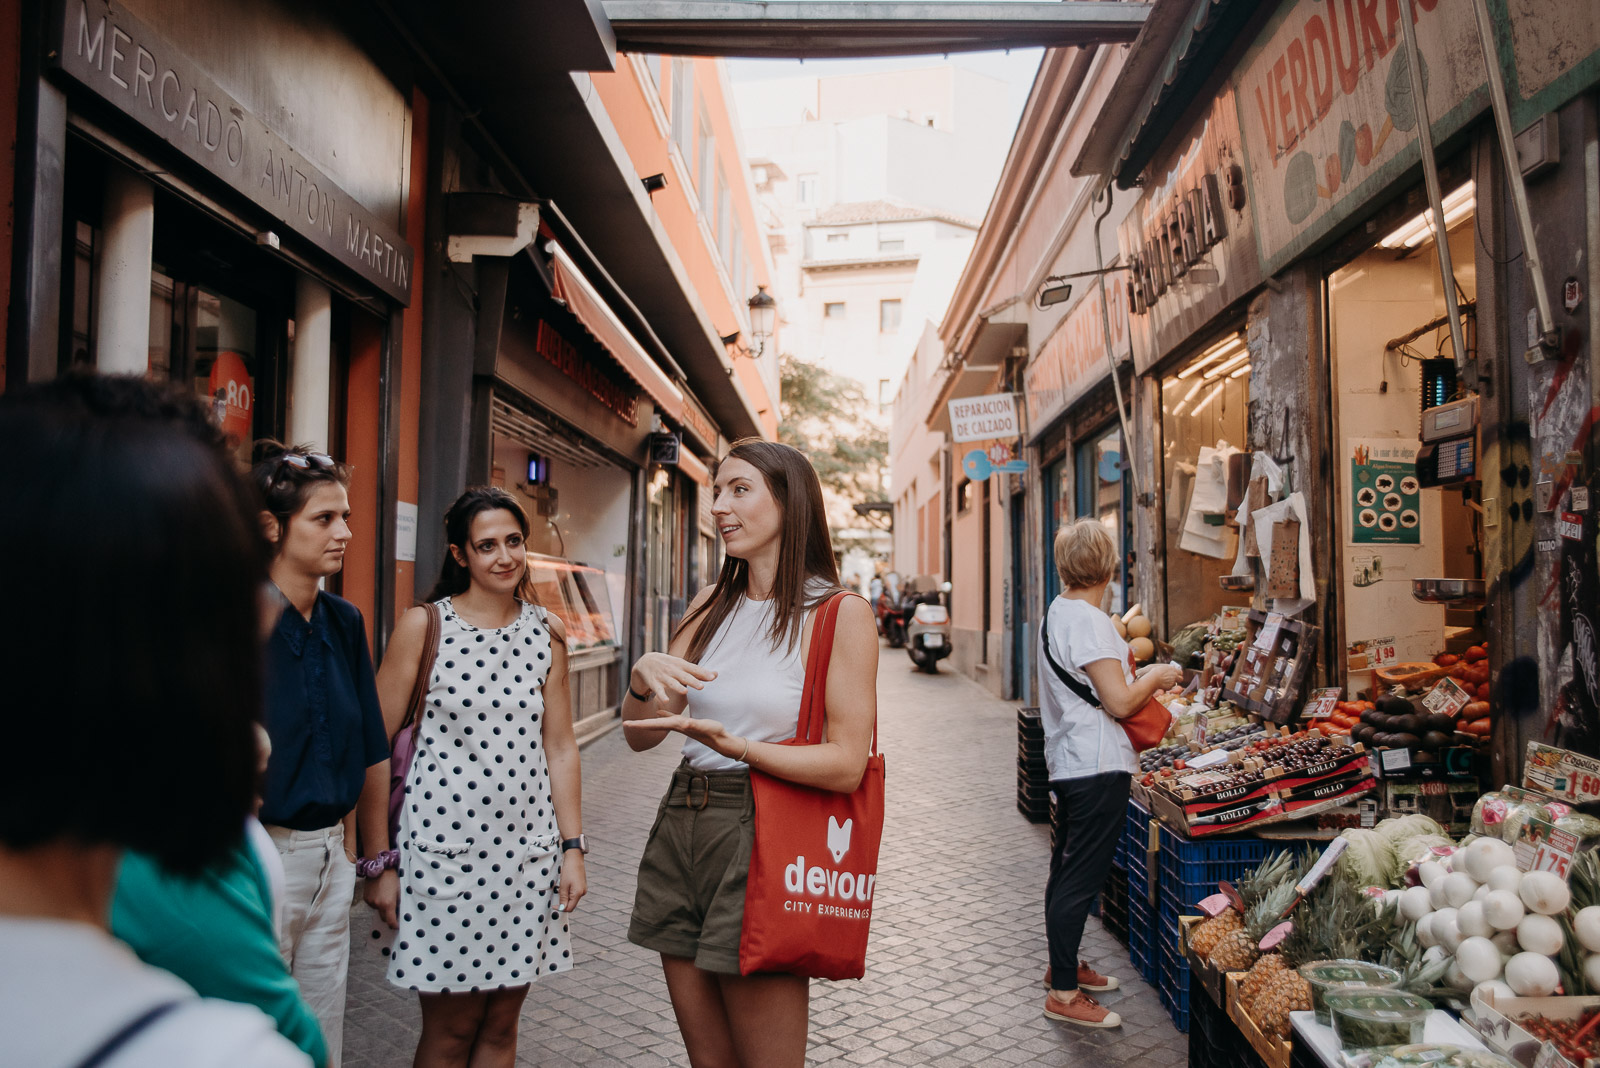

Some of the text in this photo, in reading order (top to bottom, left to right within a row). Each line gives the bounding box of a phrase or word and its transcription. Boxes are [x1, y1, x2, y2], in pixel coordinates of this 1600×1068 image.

[1255, 0, 1438, 169] VERDUR
[78, 0, 409, 290] MERCADO ANTON MARTIN
[953, 399, 1011, 418] REPARACION
[957, 417, 1012, 437] DE CALZADO
[1307, 760, 1338, 776] BOLLO
[1216, 786, 1247, 801] BOLLO
[1314, 782, 1344, 798] BOLLO
[1220, 808, 1251, 823] BOLLO
[784, 855, 877, 901] devour
[784, 900, 870, 919] CITY EXPERIENCS
